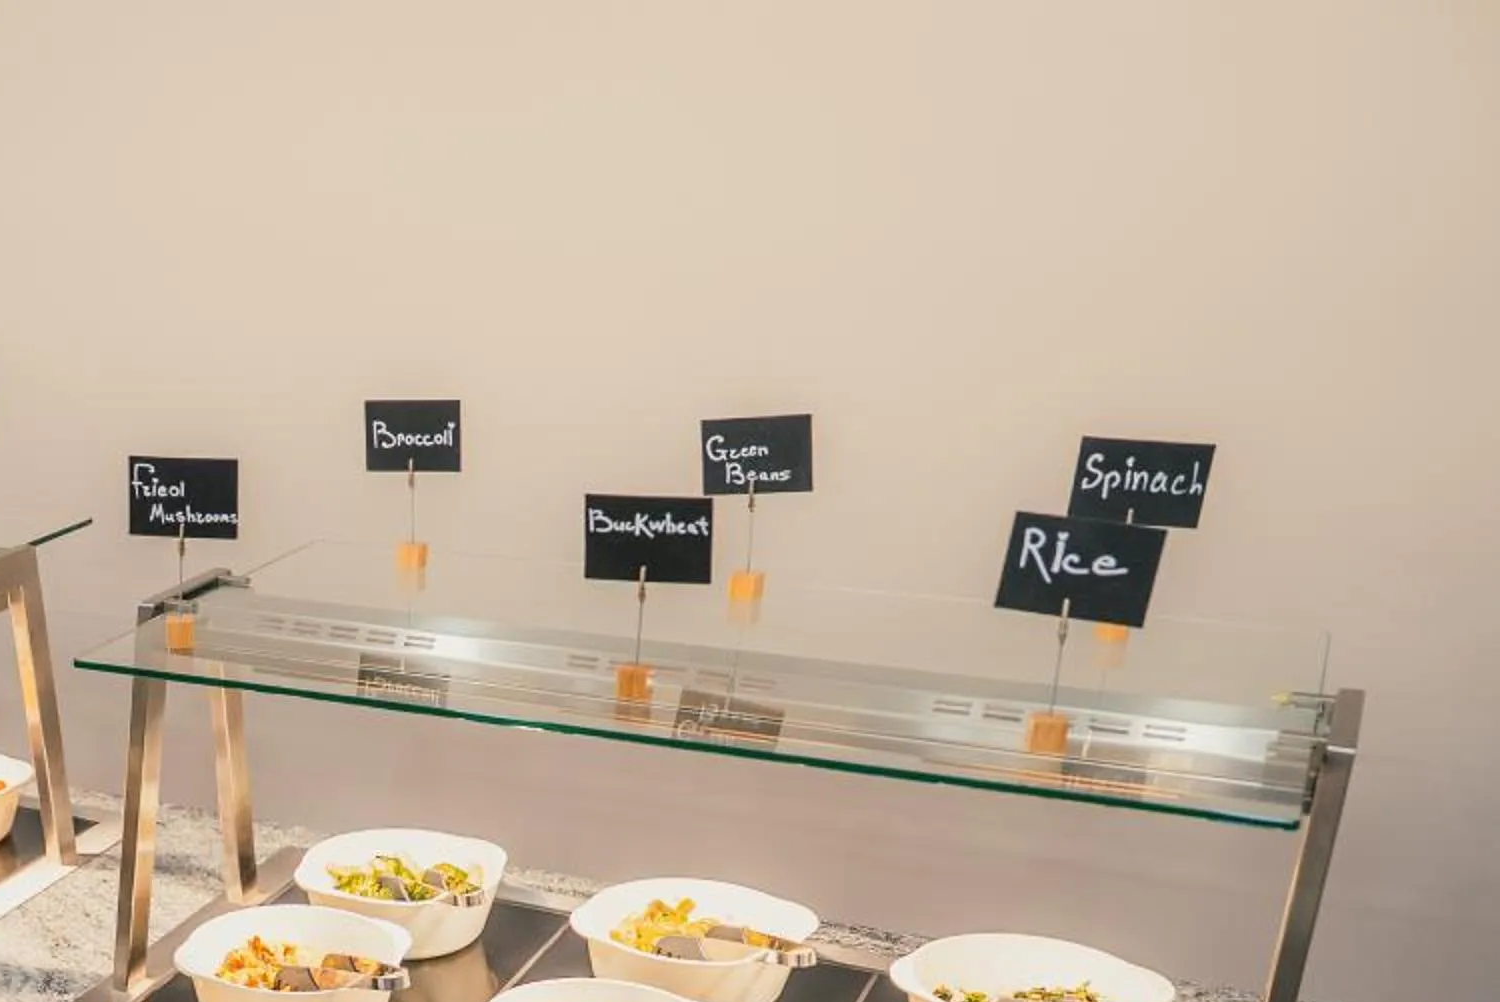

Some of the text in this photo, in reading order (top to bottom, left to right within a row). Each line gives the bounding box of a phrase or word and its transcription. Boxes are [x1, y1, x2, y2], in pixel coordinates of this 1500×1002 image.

[372, 420, 456, 448] Broccoli
[705, 434, 769, 461] Green
[724, 462, 792, 485] Beans
[1081, 453, 1203, 499] Spinach
[149, 502, 239, 525] Mushrooms
[1019, 527, 1129, 584] Rice
